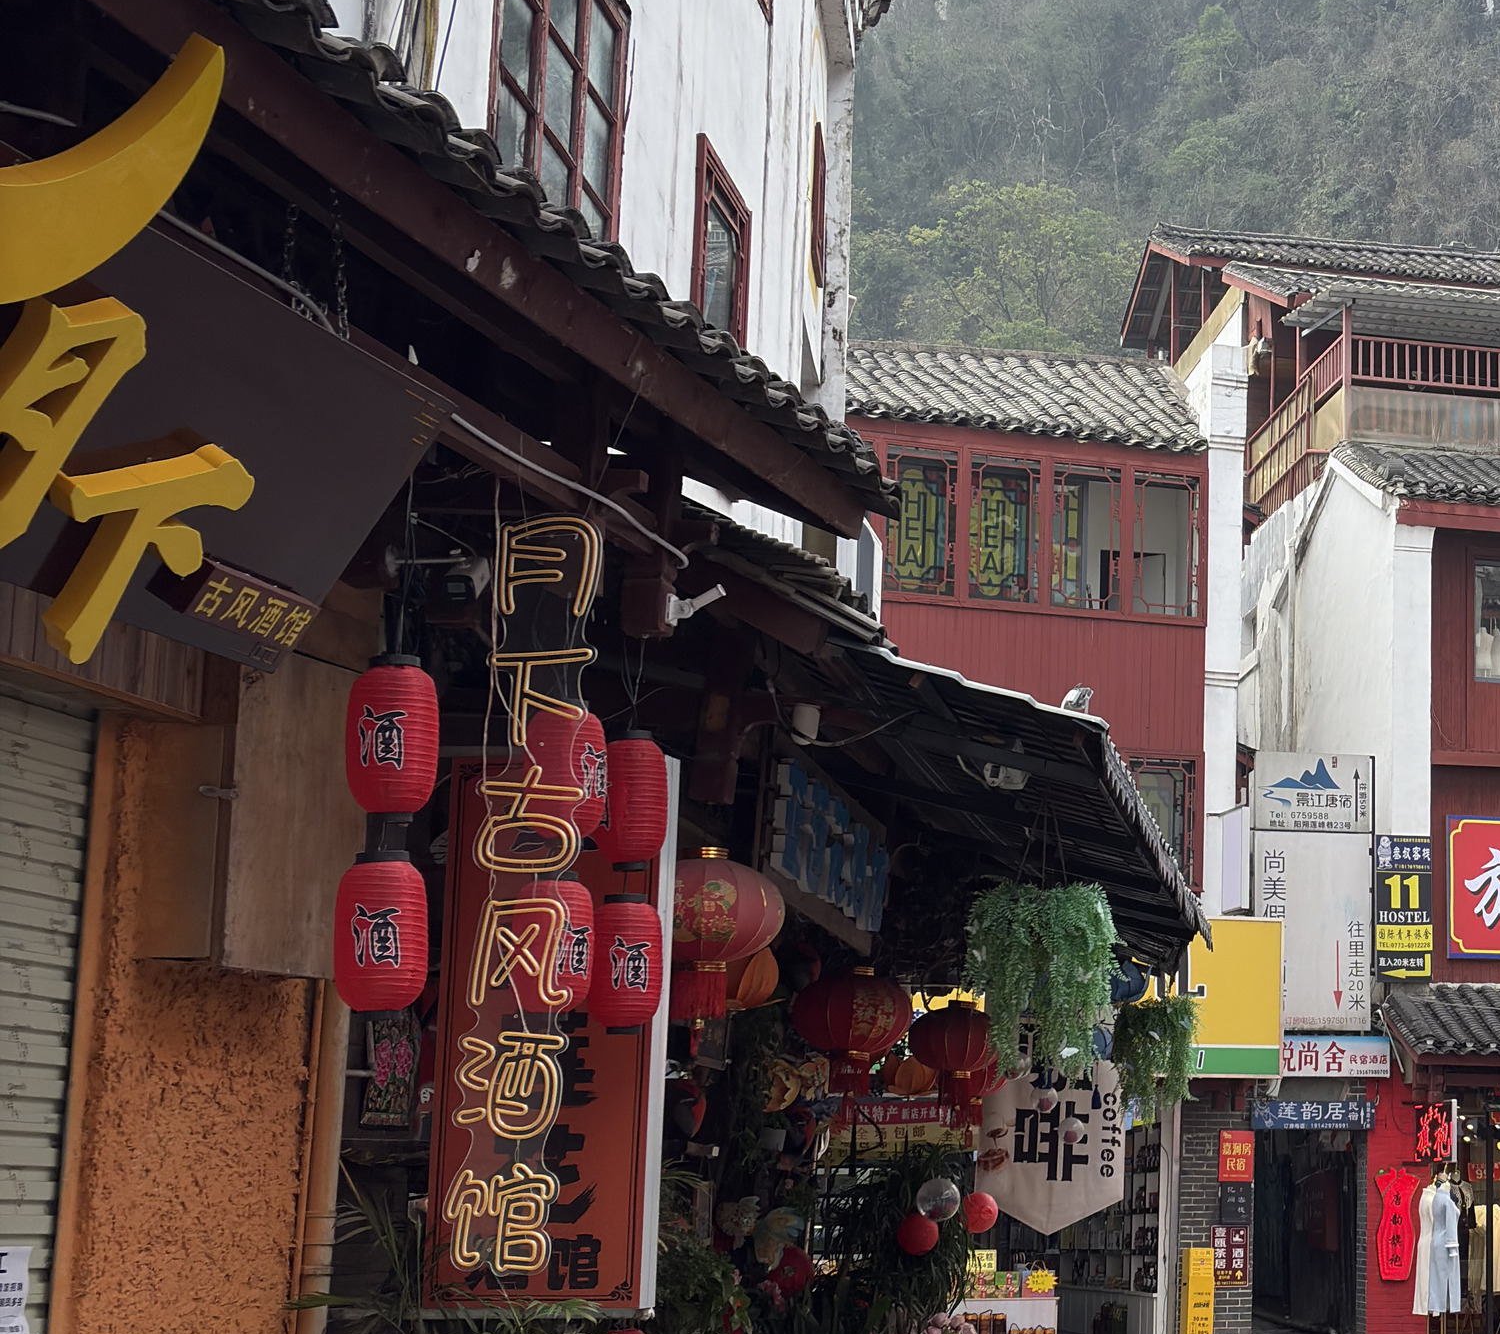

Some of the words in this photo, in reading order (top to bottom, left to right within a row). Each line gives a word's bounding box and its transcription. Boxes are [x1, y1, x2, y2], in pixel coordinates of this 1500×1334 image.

[194, 577, 312, 647] 古风酒馆
[357, 705, 407, 769] 酒
[1291, 811, 1329, 820] 6759588
[1384, 874, 1420, 909] 11
[1379, 910, 1431, 924] HOSTEL
[351, 903, 402, 967] 酒
[609, 935, 651, 992] 酒
[1347, 920, 1366, 1012] 往里走20米
[1379, 957, 1425, 968] 直入20米左转
[1349, 1054, 1388, 1065] 民宿酒店
[1277, 1101, 1346, 1120] 莲韵居
[1348, 1101, 1359, 1121] 民宿
[1100, 1092, 1121, 1178] coffee
[1226, 1157, 1246, 1171] 民宿
[1231, 1247, 1244, 1269] 酒店
